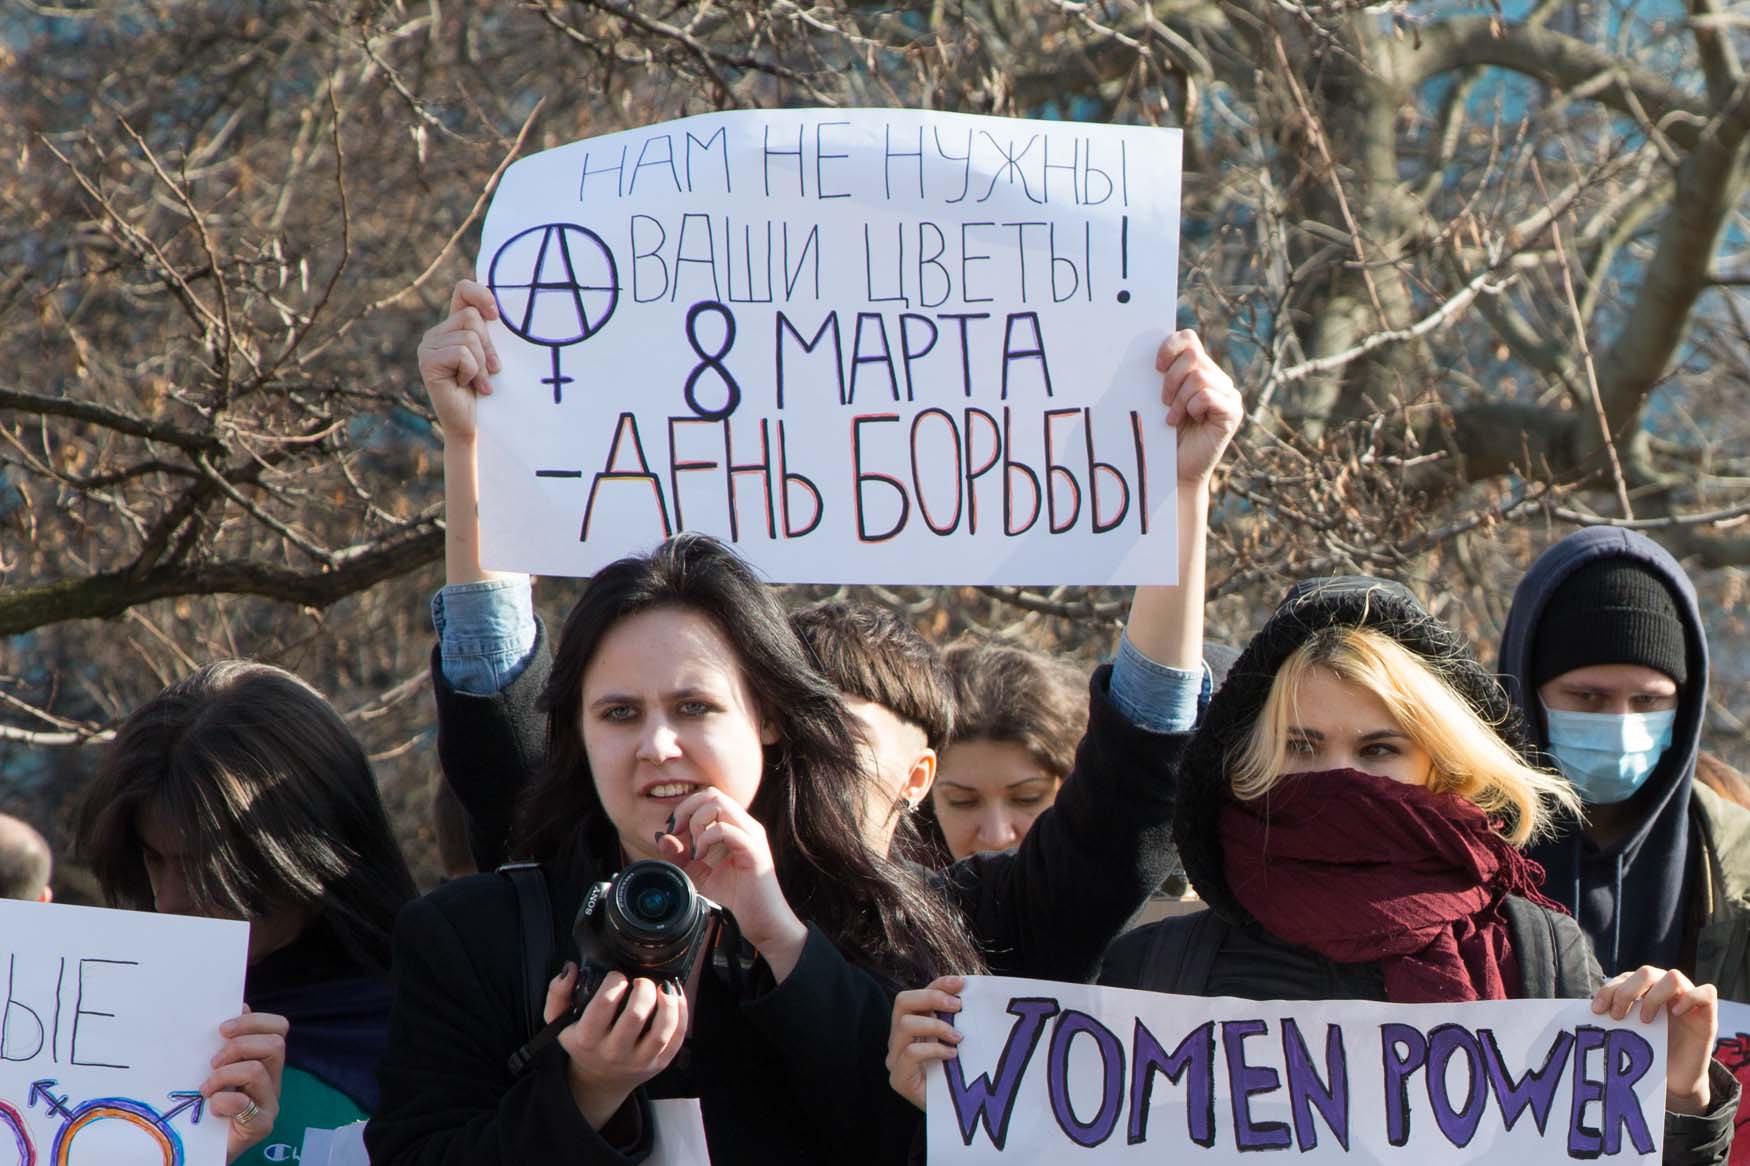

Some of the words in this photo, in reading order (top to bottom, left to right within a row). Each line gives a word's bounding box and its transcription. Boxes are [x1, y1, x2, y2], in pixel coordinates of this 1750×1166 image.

[580, 126, 731, 202] НАМ
[763, 121, 852, 199] НЕ
[885, 124, 1130, 207] НУЖНЫ
[630, 213, 821, 305] ВАШИ
[866, 215, 1132, 310] ЦВЕТЫ!
[683, 299, 743, 421] 8
[776, 310, 1054, 410] МАРТА
[850, 406, 1152, 544] БОРЬБЫ
[584, 886, 602, 916] SONY
[940, 997, 1351, 1153] WOMEN
[1380, 1022, 1656, 1161] POWER
